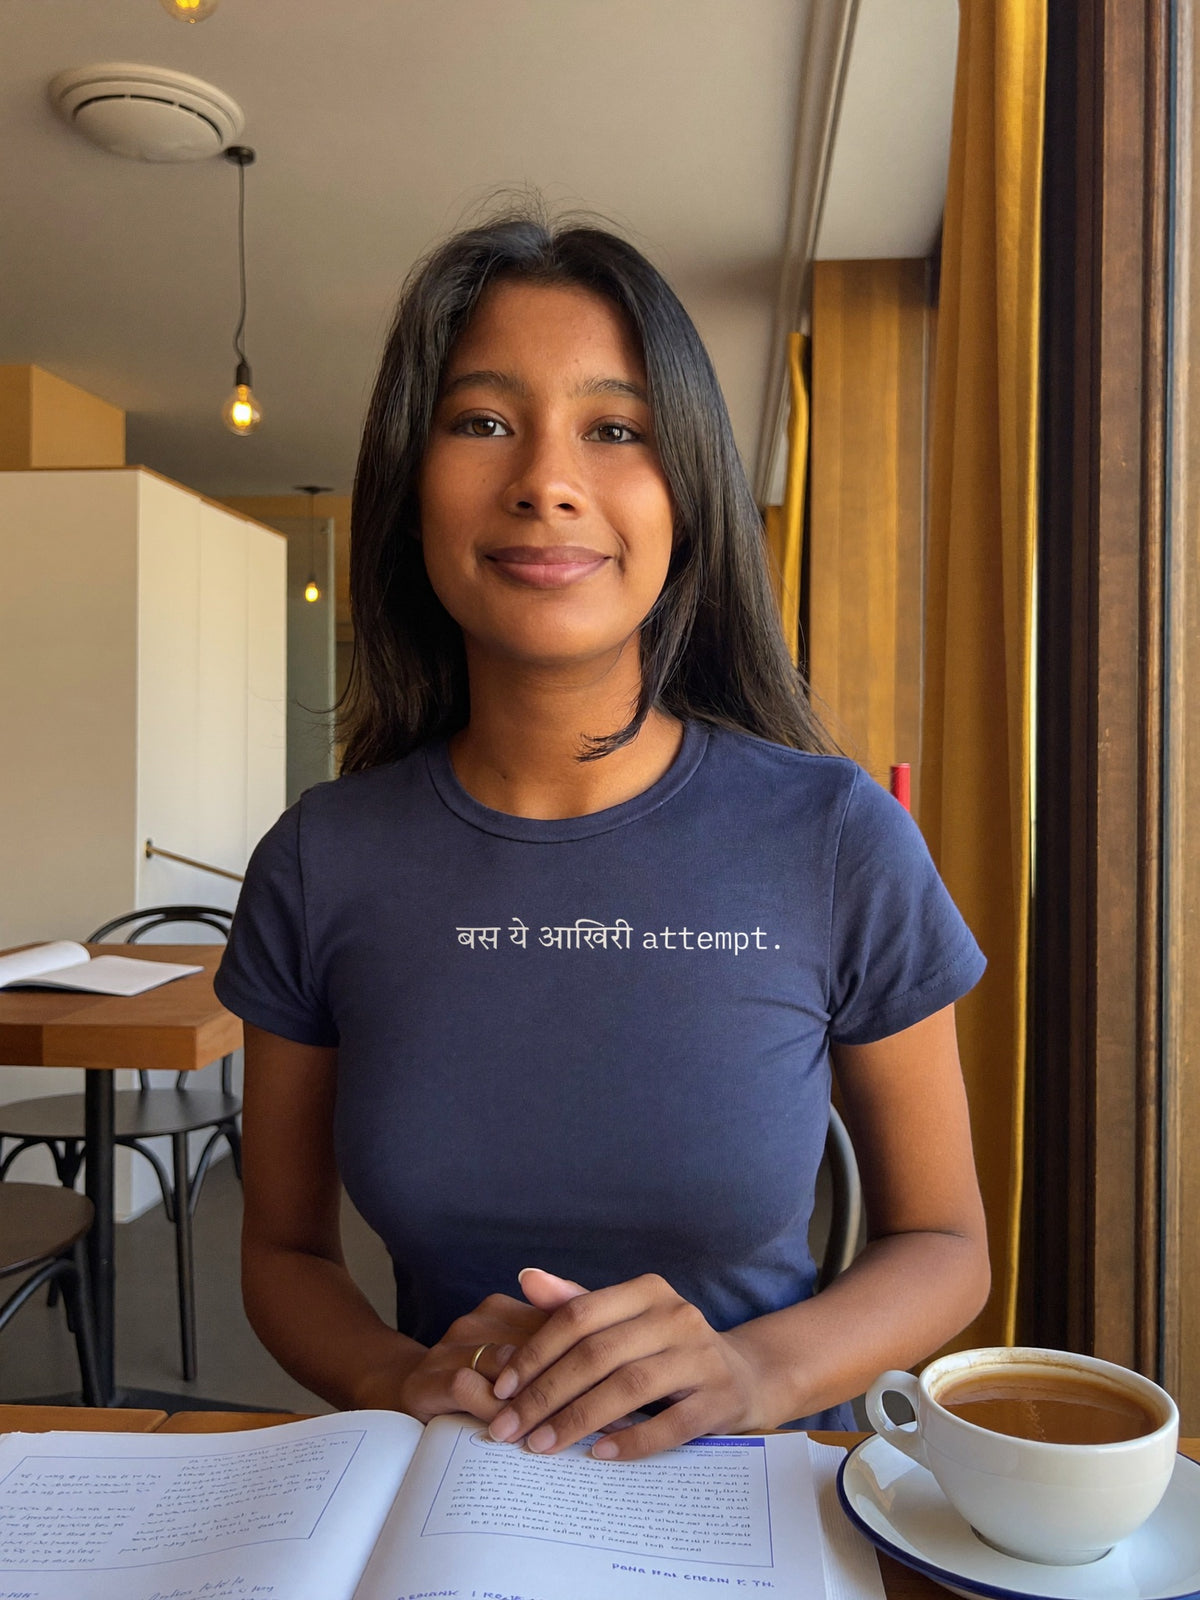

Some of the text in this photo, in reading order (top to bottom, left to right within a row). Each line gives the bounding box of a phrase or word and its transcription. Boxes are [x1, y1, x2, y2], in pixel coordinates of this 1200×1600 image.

[455, 917, 781, 956] बस ये आखिरी attempt.
